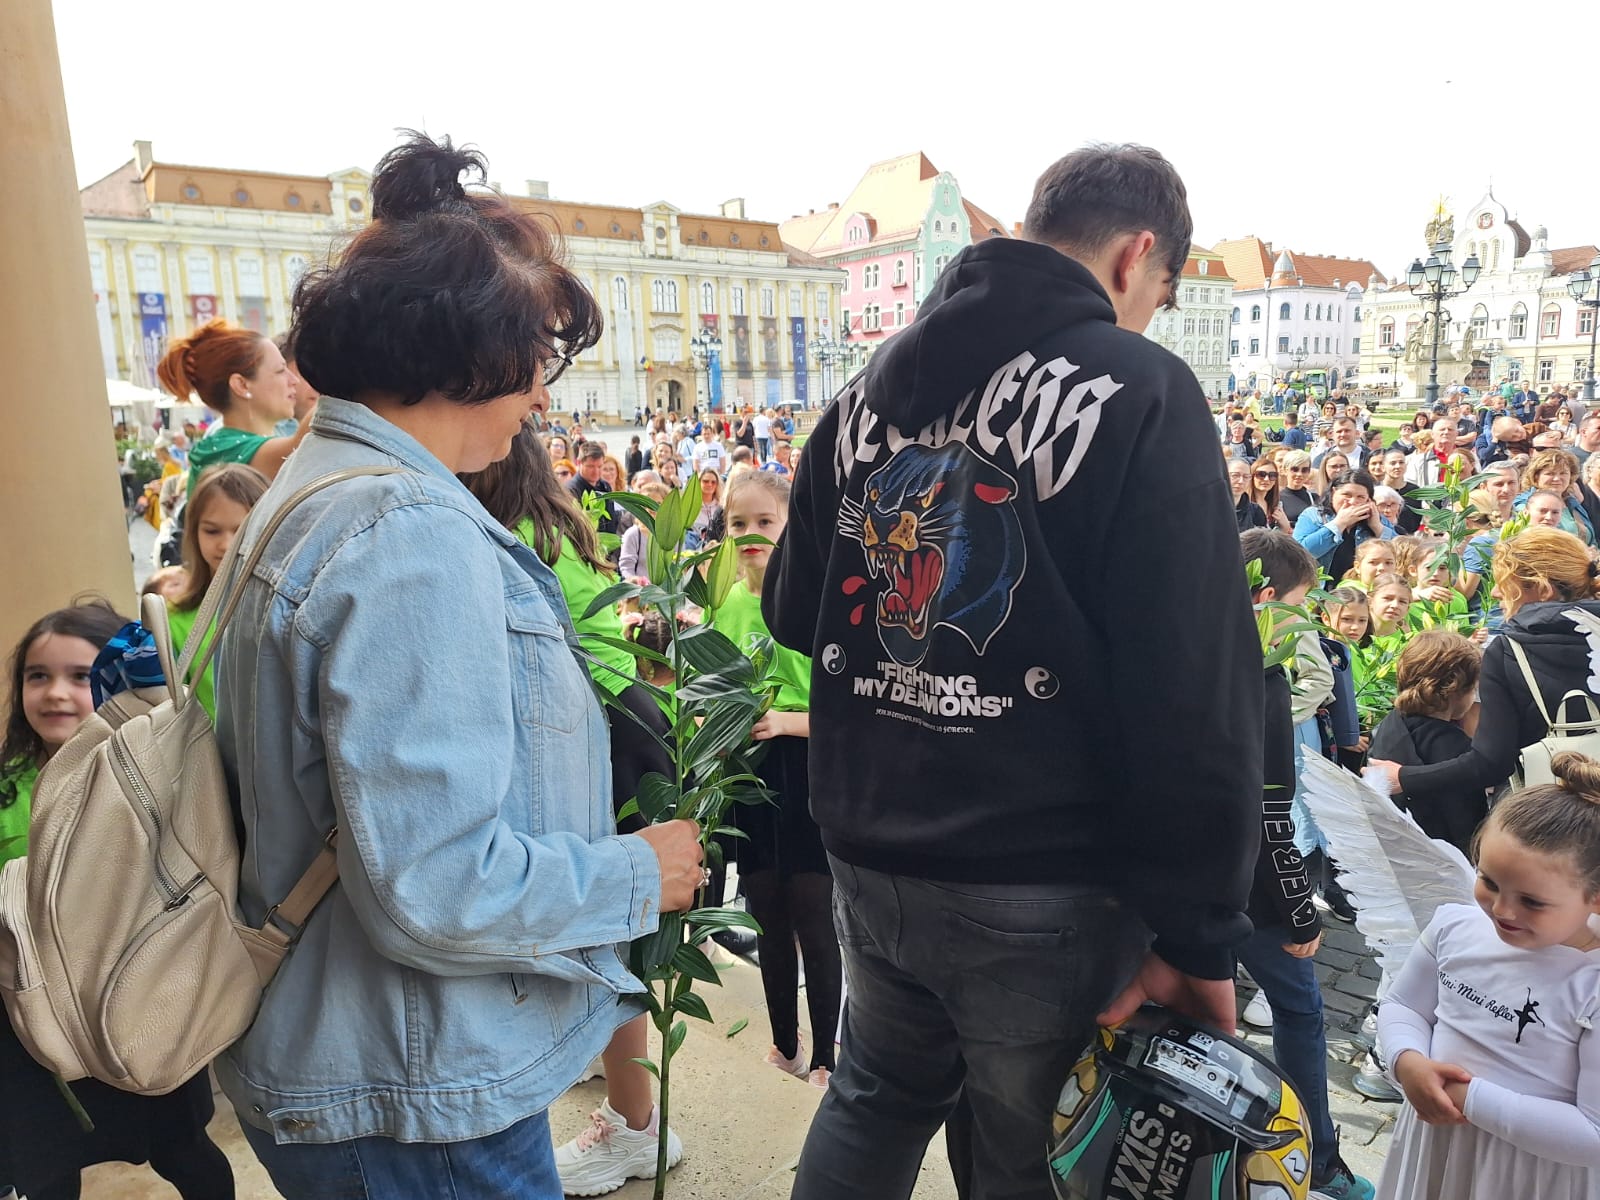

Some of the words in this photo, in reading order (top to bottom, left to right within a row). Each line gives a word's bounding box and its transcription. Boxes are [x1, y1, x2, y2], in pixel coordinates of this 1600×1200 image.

[853, 677, 889, 699] MY
[1485, 999, 1516, 1022] Reflex
[1106, 1110, 1164, 1200] XXIS
